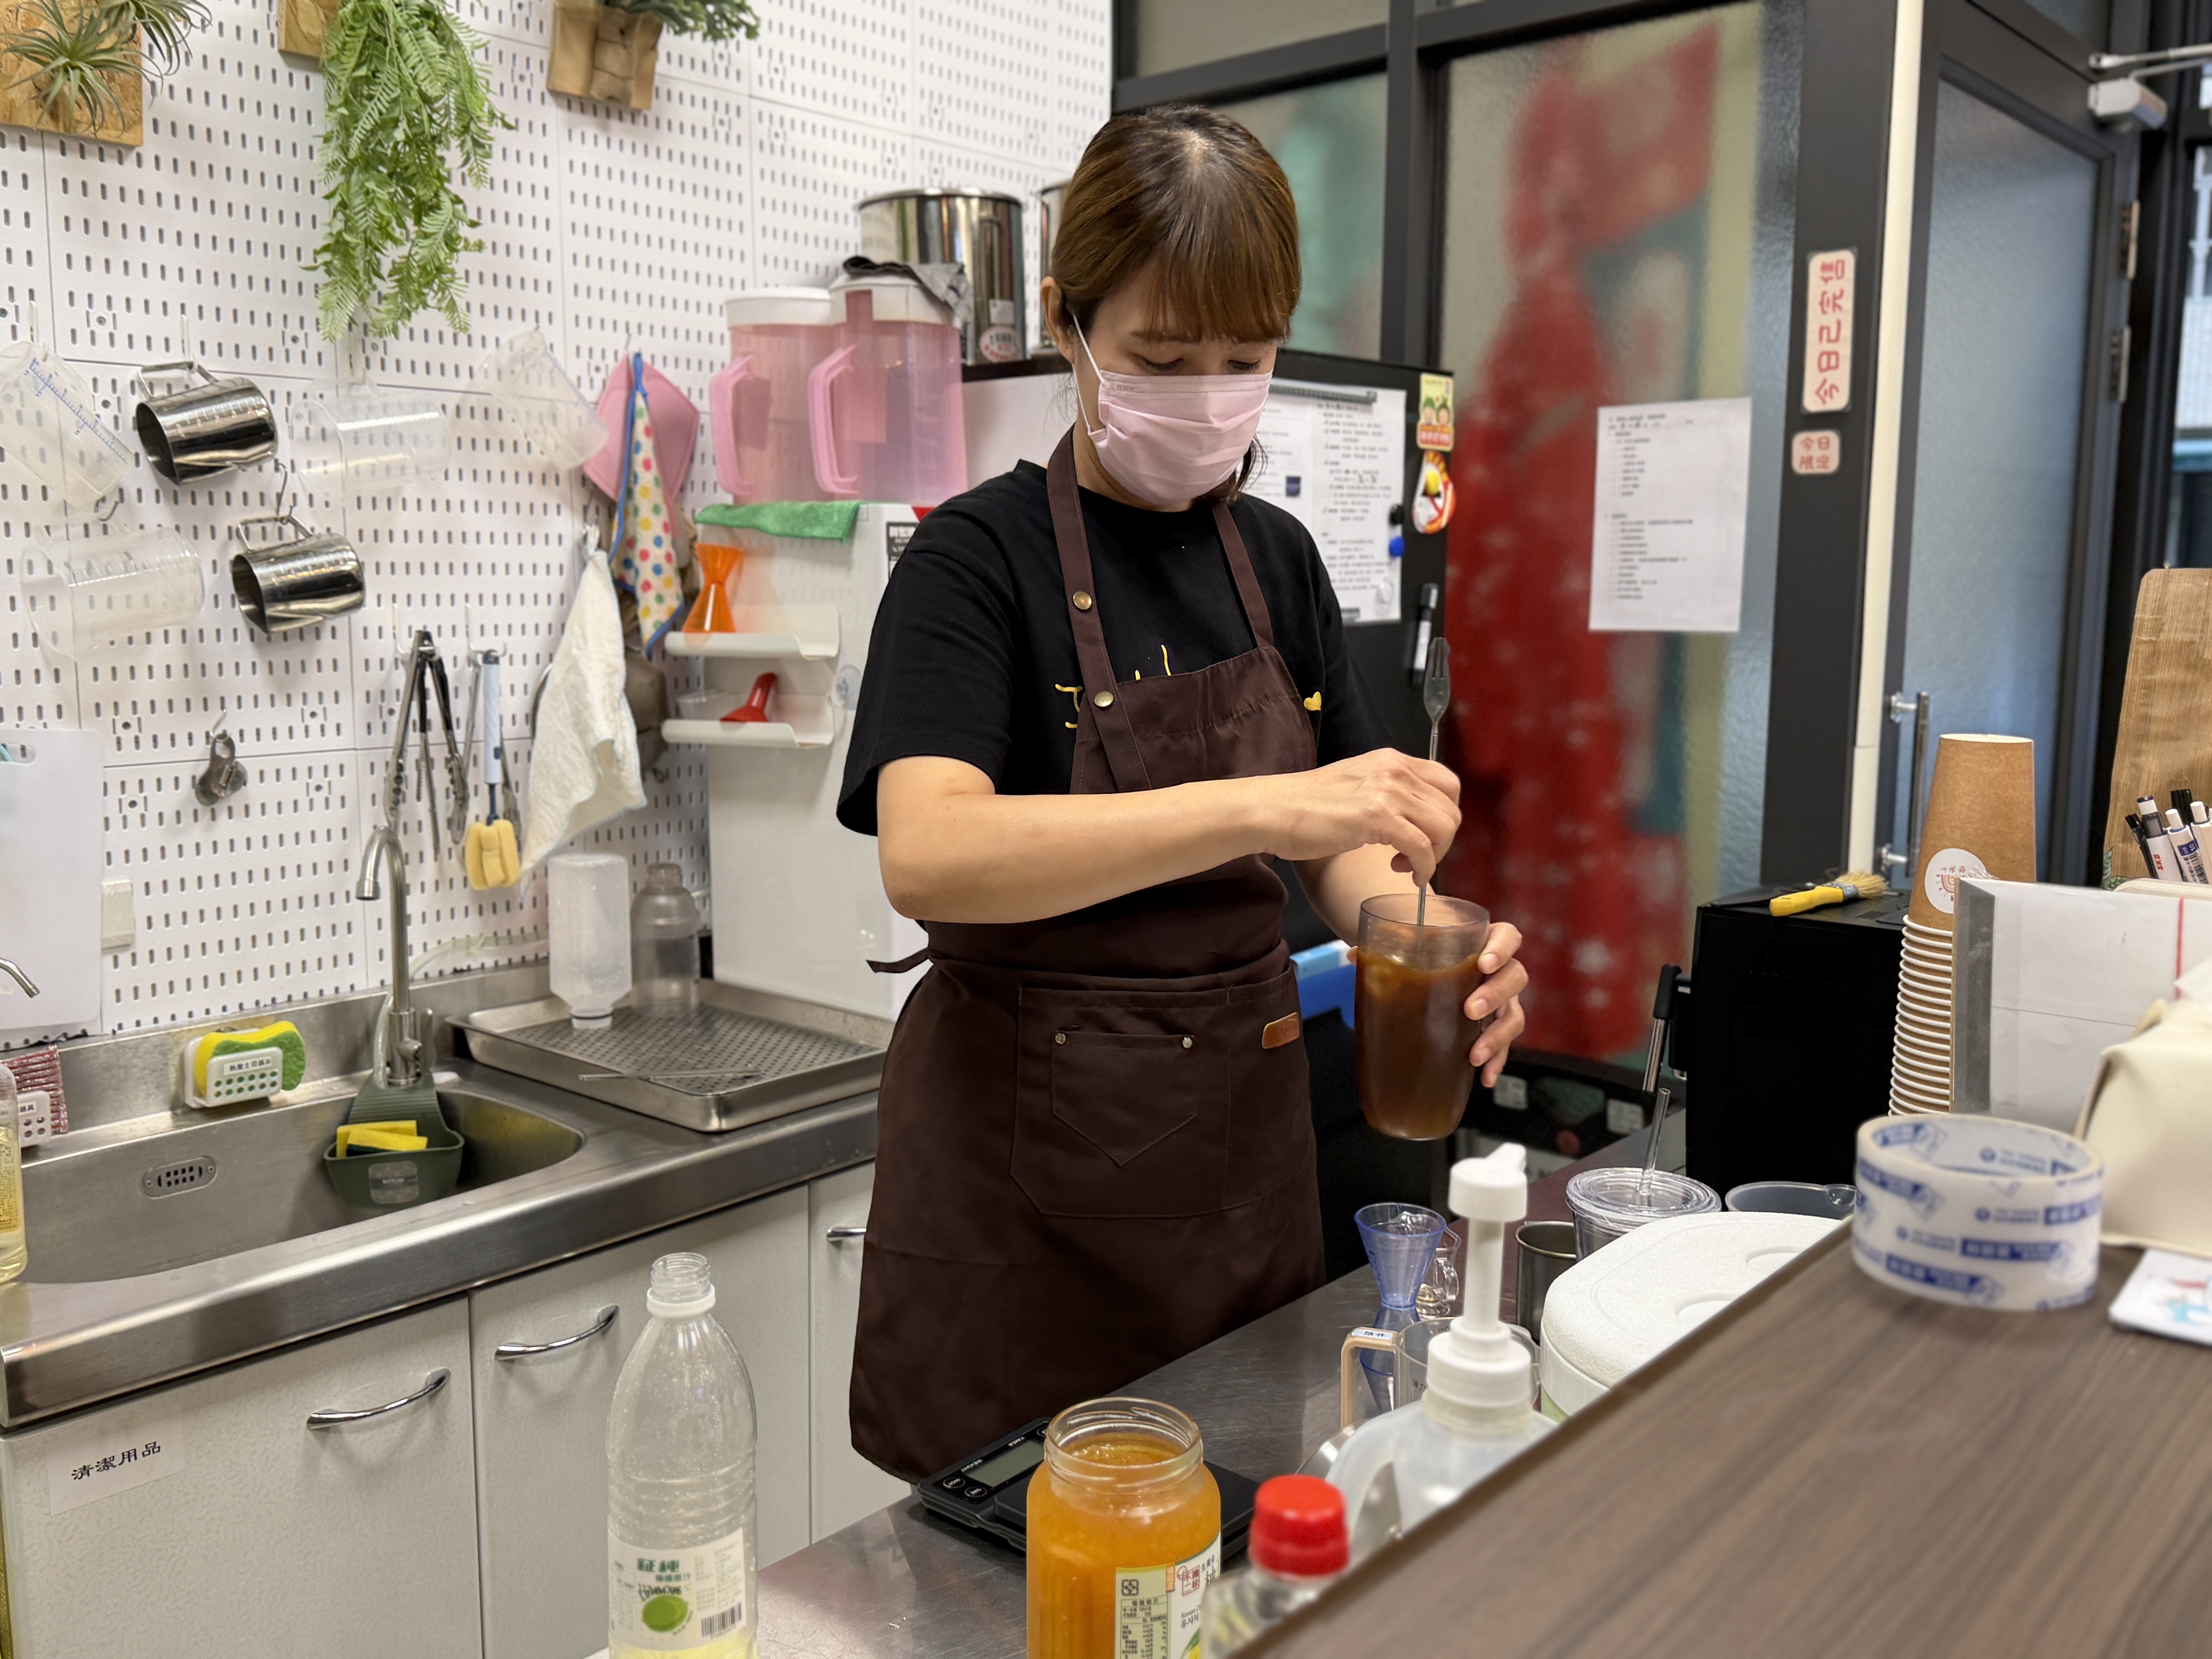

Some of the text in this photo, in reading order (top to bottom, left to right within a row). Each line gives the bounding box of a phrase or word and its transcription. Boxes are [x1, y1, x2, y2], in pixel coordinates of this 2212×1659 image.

[1800, 436, 1831, 452] 今日
[1799, 455, 1830, 470] 限定
[2154, 854, 2164, 871] SKB
[71, 1441, 161, 1480] 清潔用品
